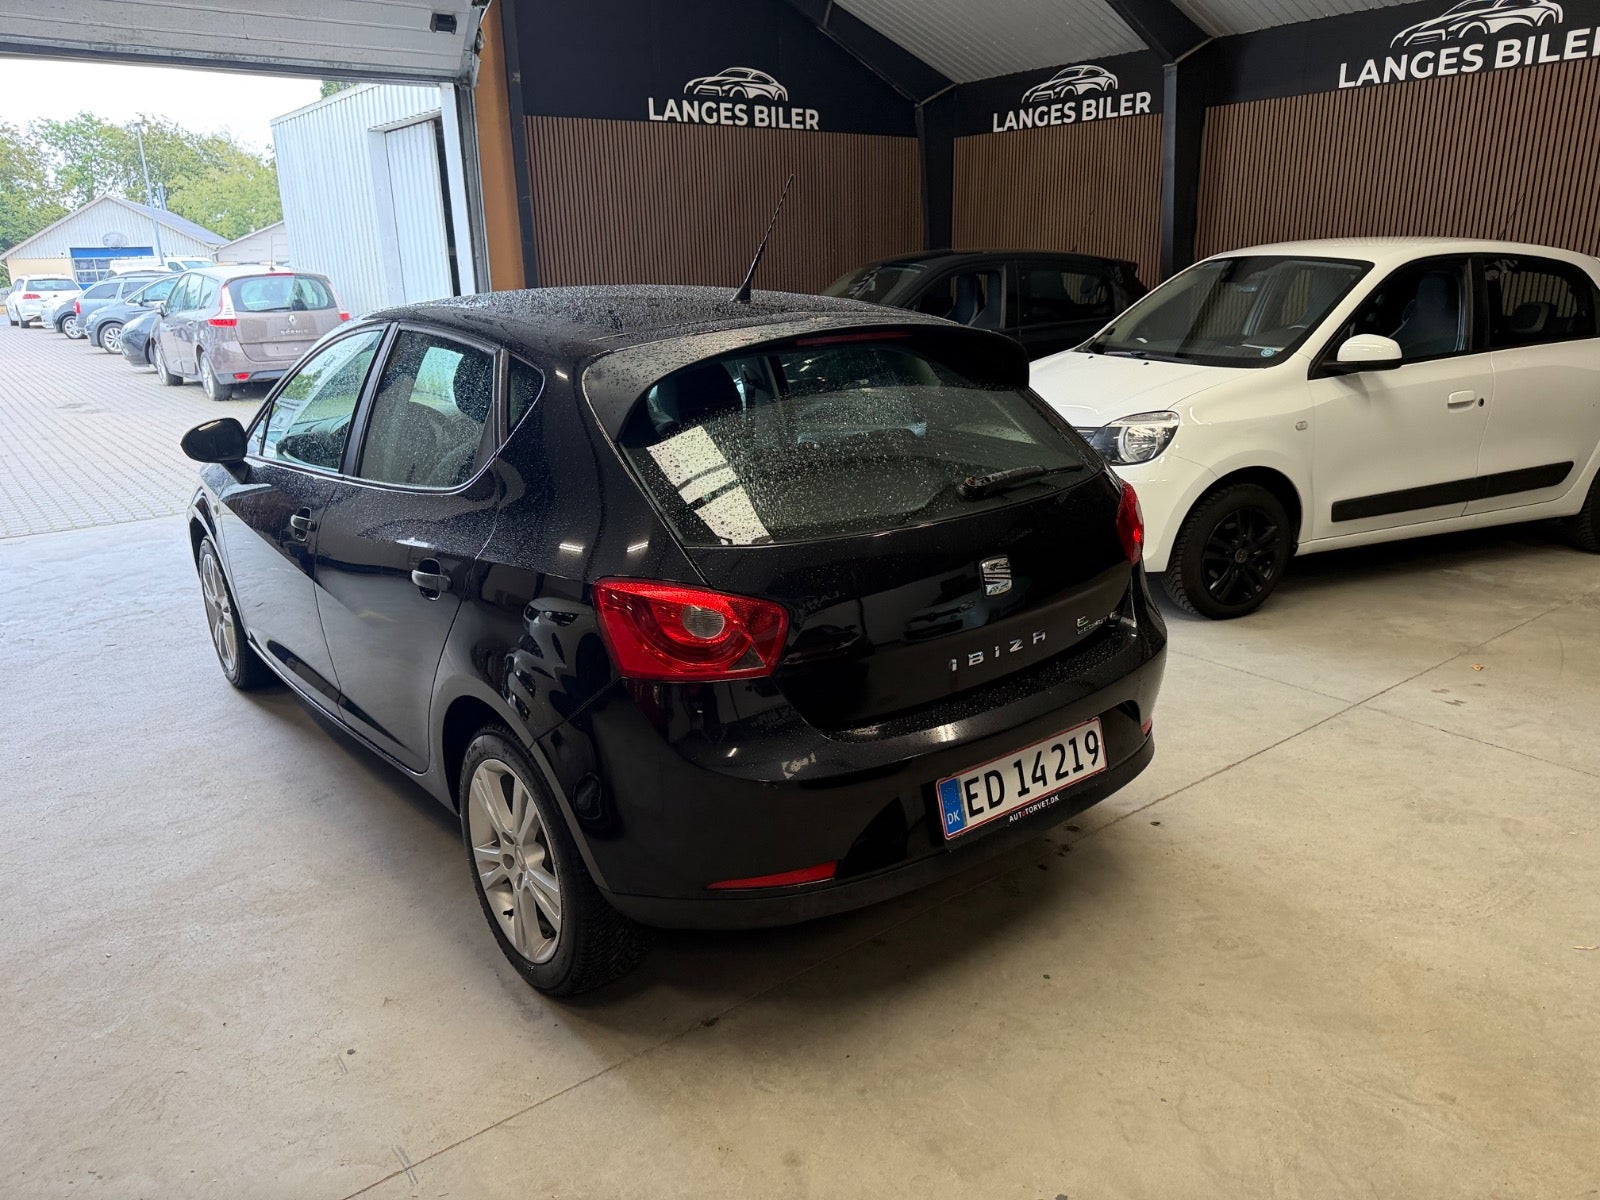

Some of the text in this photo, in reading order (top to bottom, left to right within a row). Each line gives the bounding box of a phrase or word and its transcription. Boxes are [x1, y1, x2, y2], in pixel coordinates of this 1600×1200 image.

[1338, 43, 1485, 89] LANGES
[648, 97, 819, 130] LANGES BILER
[992, 91, 1151, 133] LANGES BILER
[963, 769, 1005, 818] ED
[947, 809, 960, 825] DK
